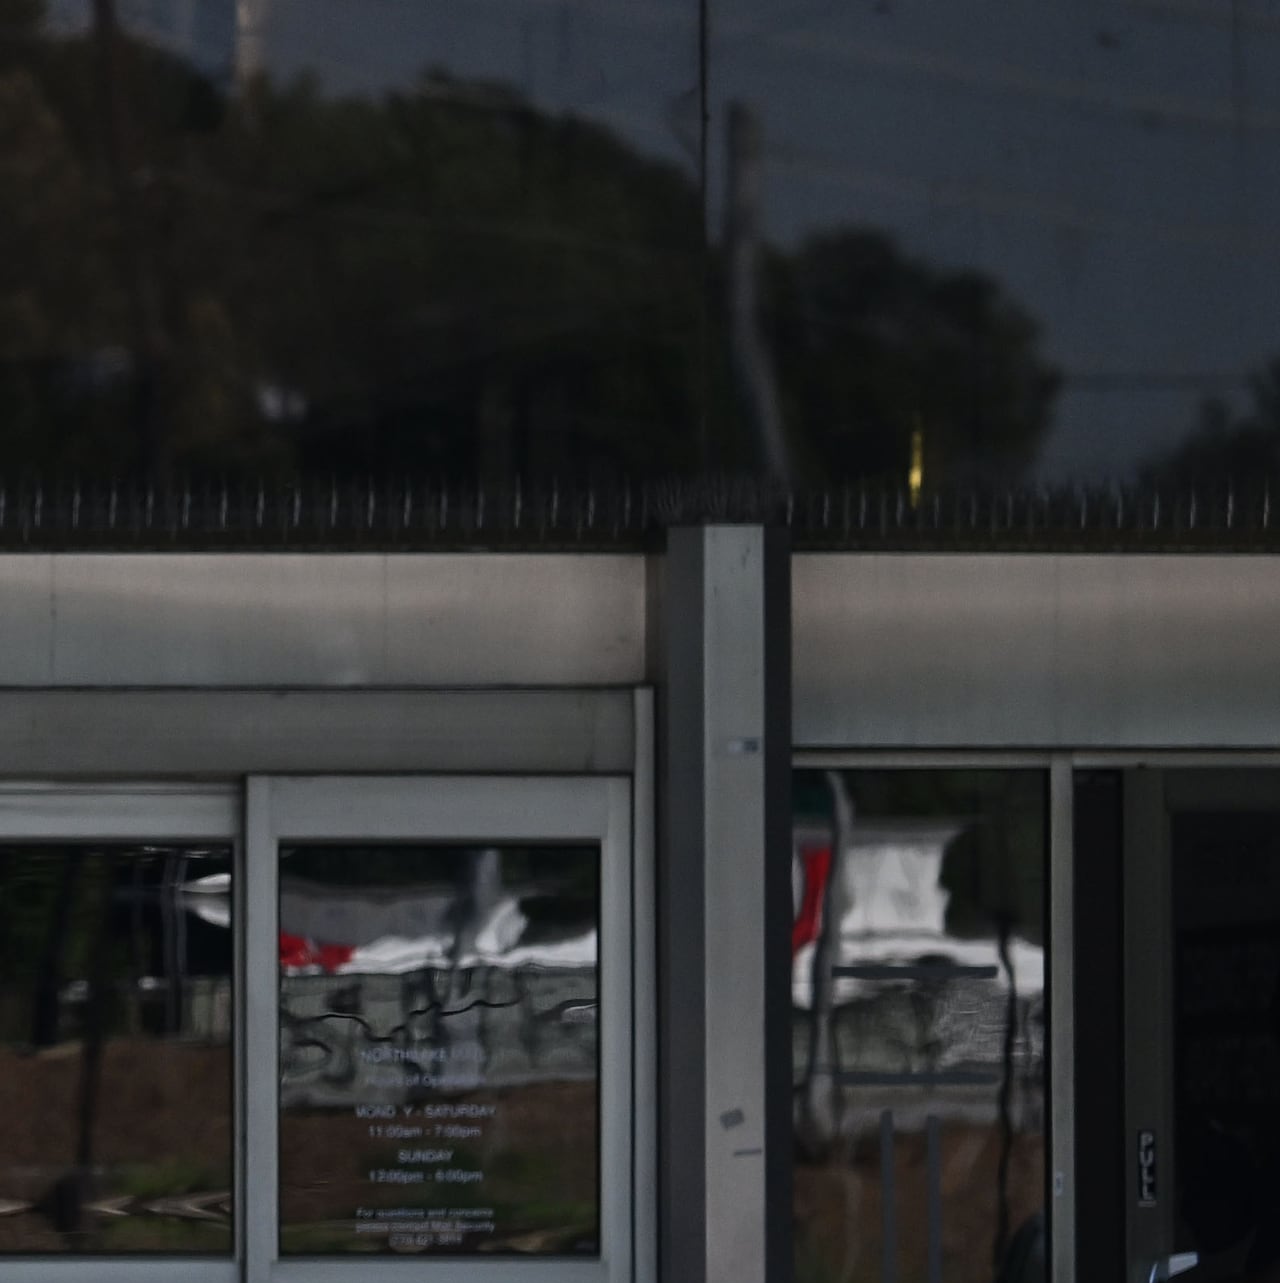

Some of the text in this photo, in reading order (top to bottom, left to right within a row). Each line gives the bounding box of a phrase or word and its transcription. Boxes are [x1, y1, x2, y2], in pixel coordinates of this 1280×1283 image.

[355, 1104, 413, 1119] MONDY
[424, 1103, 497, 1119] SATURDAY
[368, 1125, 424, 1139] 11:00am
[434, 1126, 482, 1140] 7:00pm
[398, 1149, 454, 1164] SUNDAY
[1139, 1132, 1154, 1200] PULL
